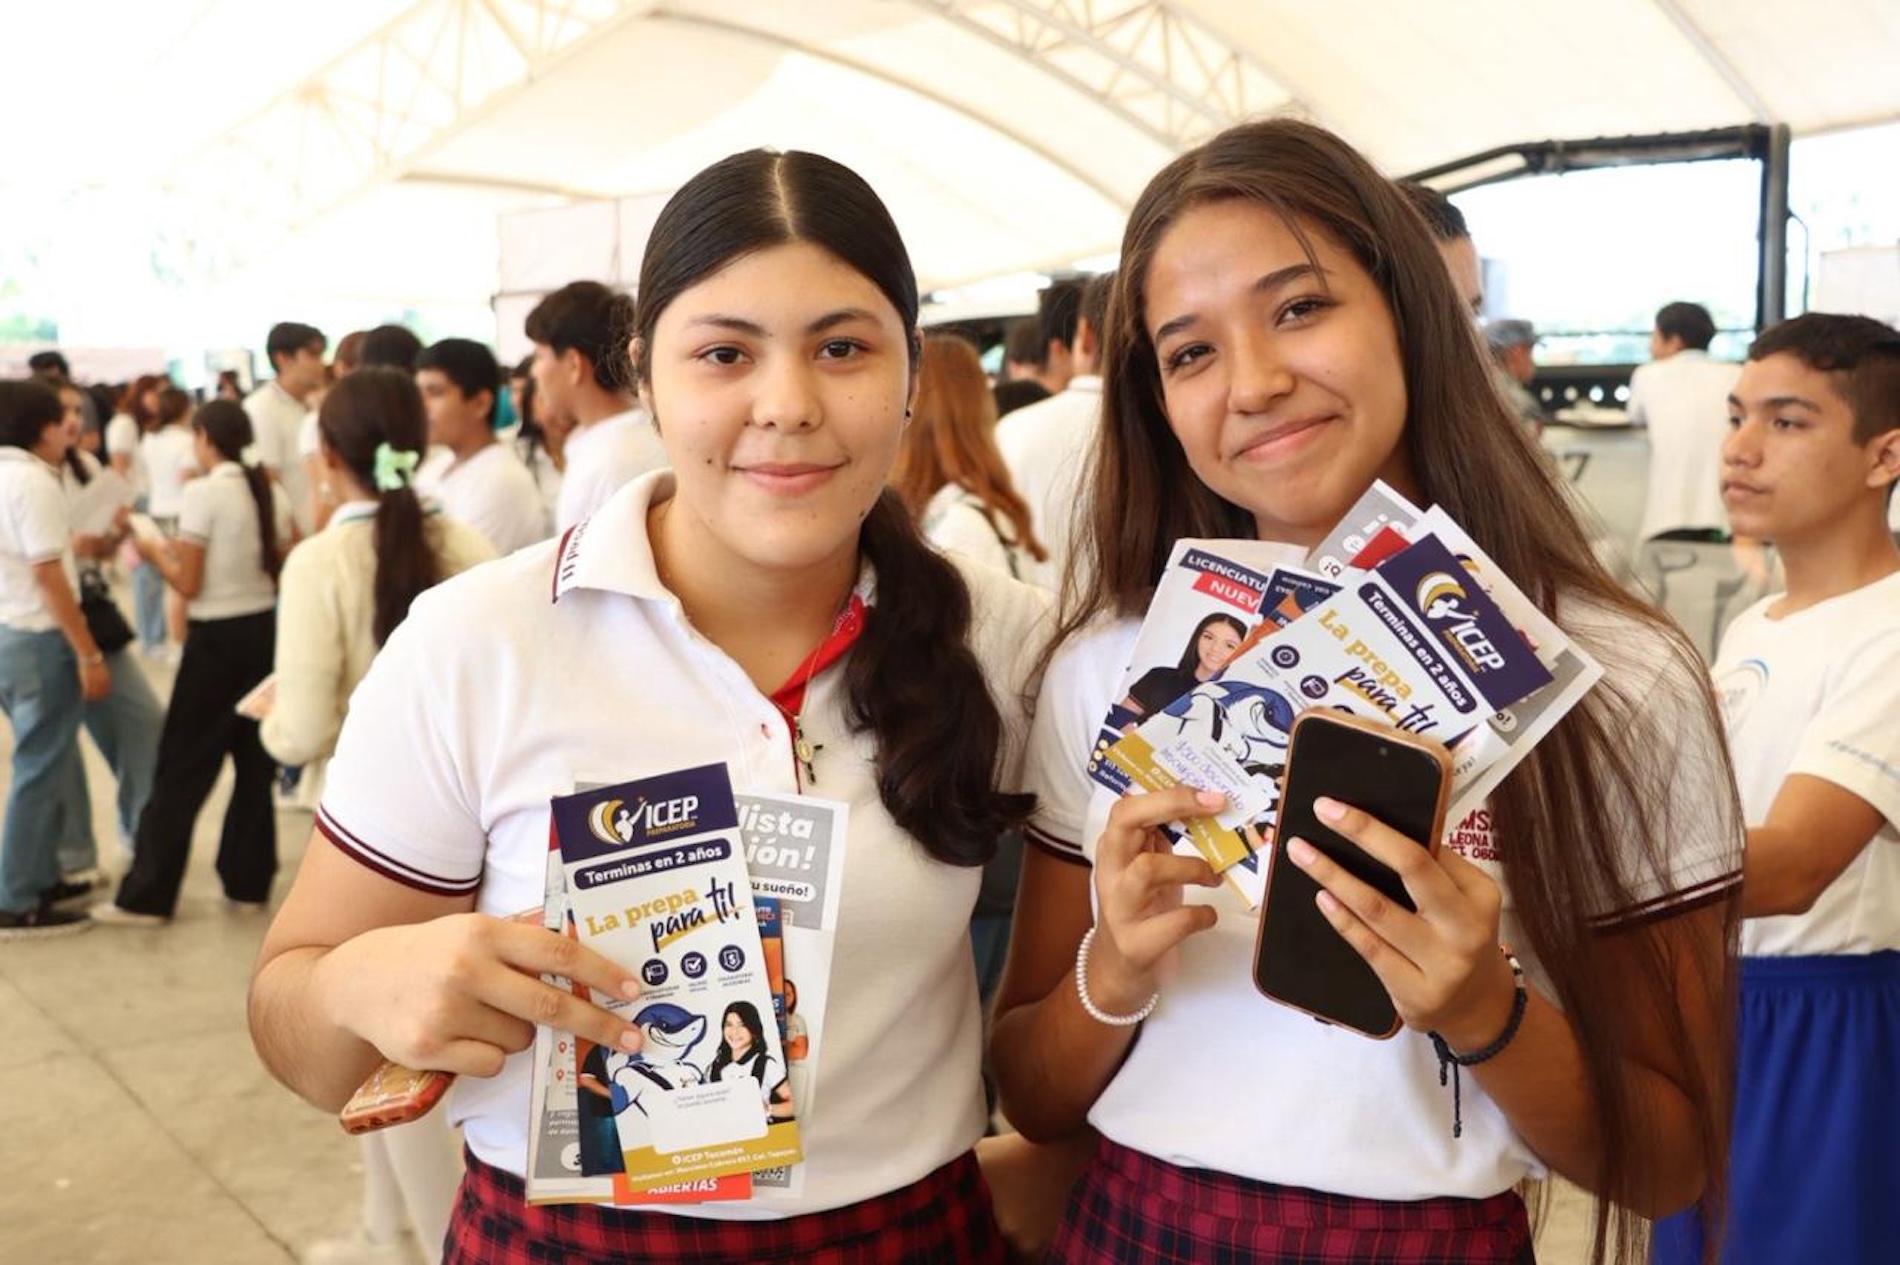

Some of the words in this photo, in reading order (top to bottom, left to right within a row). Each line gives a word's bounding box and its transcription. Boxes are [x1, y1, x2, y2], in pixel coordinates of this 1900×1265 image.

[1187, 555, 1266, 592] LICENCIATU
[1209, 580, 1260, 609] NUEV
[1318, 609, 1350, 641] La
[1344, 639, 1413, 702] prepa
[1368, 591, 1417, 649] Terminas
[1416, 647, 1434, 666] en
[1429, 662, 1444, 675] 2
[1438, 673, 1468, 707] años
[1449, 620, 1506, 670] ICEP
[1333, 666, 1398, 713] para
[645, 795, 699, 830] ICEP
[737, 803, 815, 839] lista
[746, 837, 816, 871] ión!
[1449, 832, 1489, 847] LEONA
[584, 859, 653, 885] Terminas
[654, 855, 673, 868] en
[675, 851, 686, 864] 2
[688, 845, 723, 862] años
[762, 884, 809, 897] sueño!
[585, 913, 621, 937] La
[624, 888, 700, 929] prepa
[650, 907, 706, 954] para
[705, 876, 740, 924] ti!
